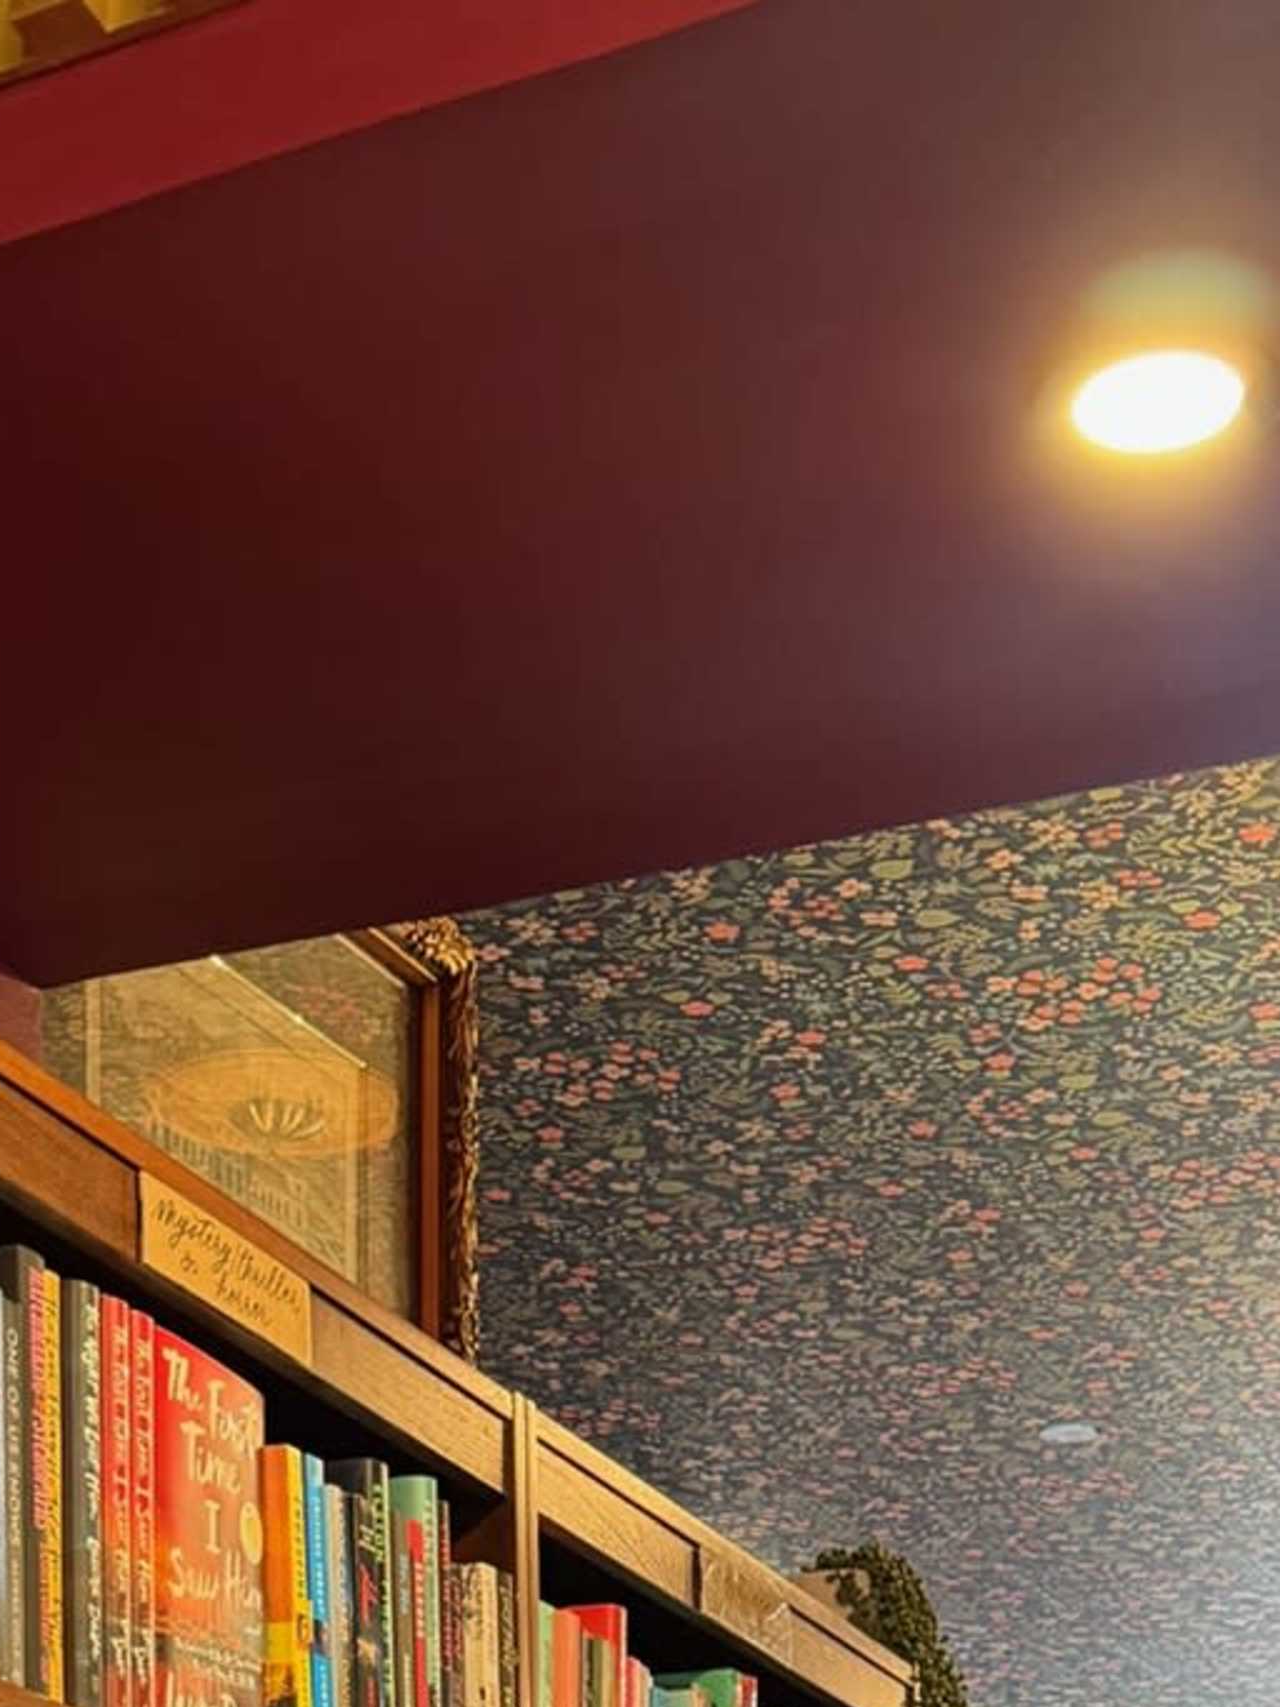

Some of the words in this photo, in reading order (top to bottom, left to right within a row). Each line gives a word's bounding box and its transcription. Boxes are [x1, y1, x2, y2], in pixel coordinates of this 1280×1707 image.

[163, 1346, 199, 1412] The
[180, 1419, 240, 1492] Time
[204, 1502, 221, 1553] I
[168, 1548, 220, 1600] Saw
